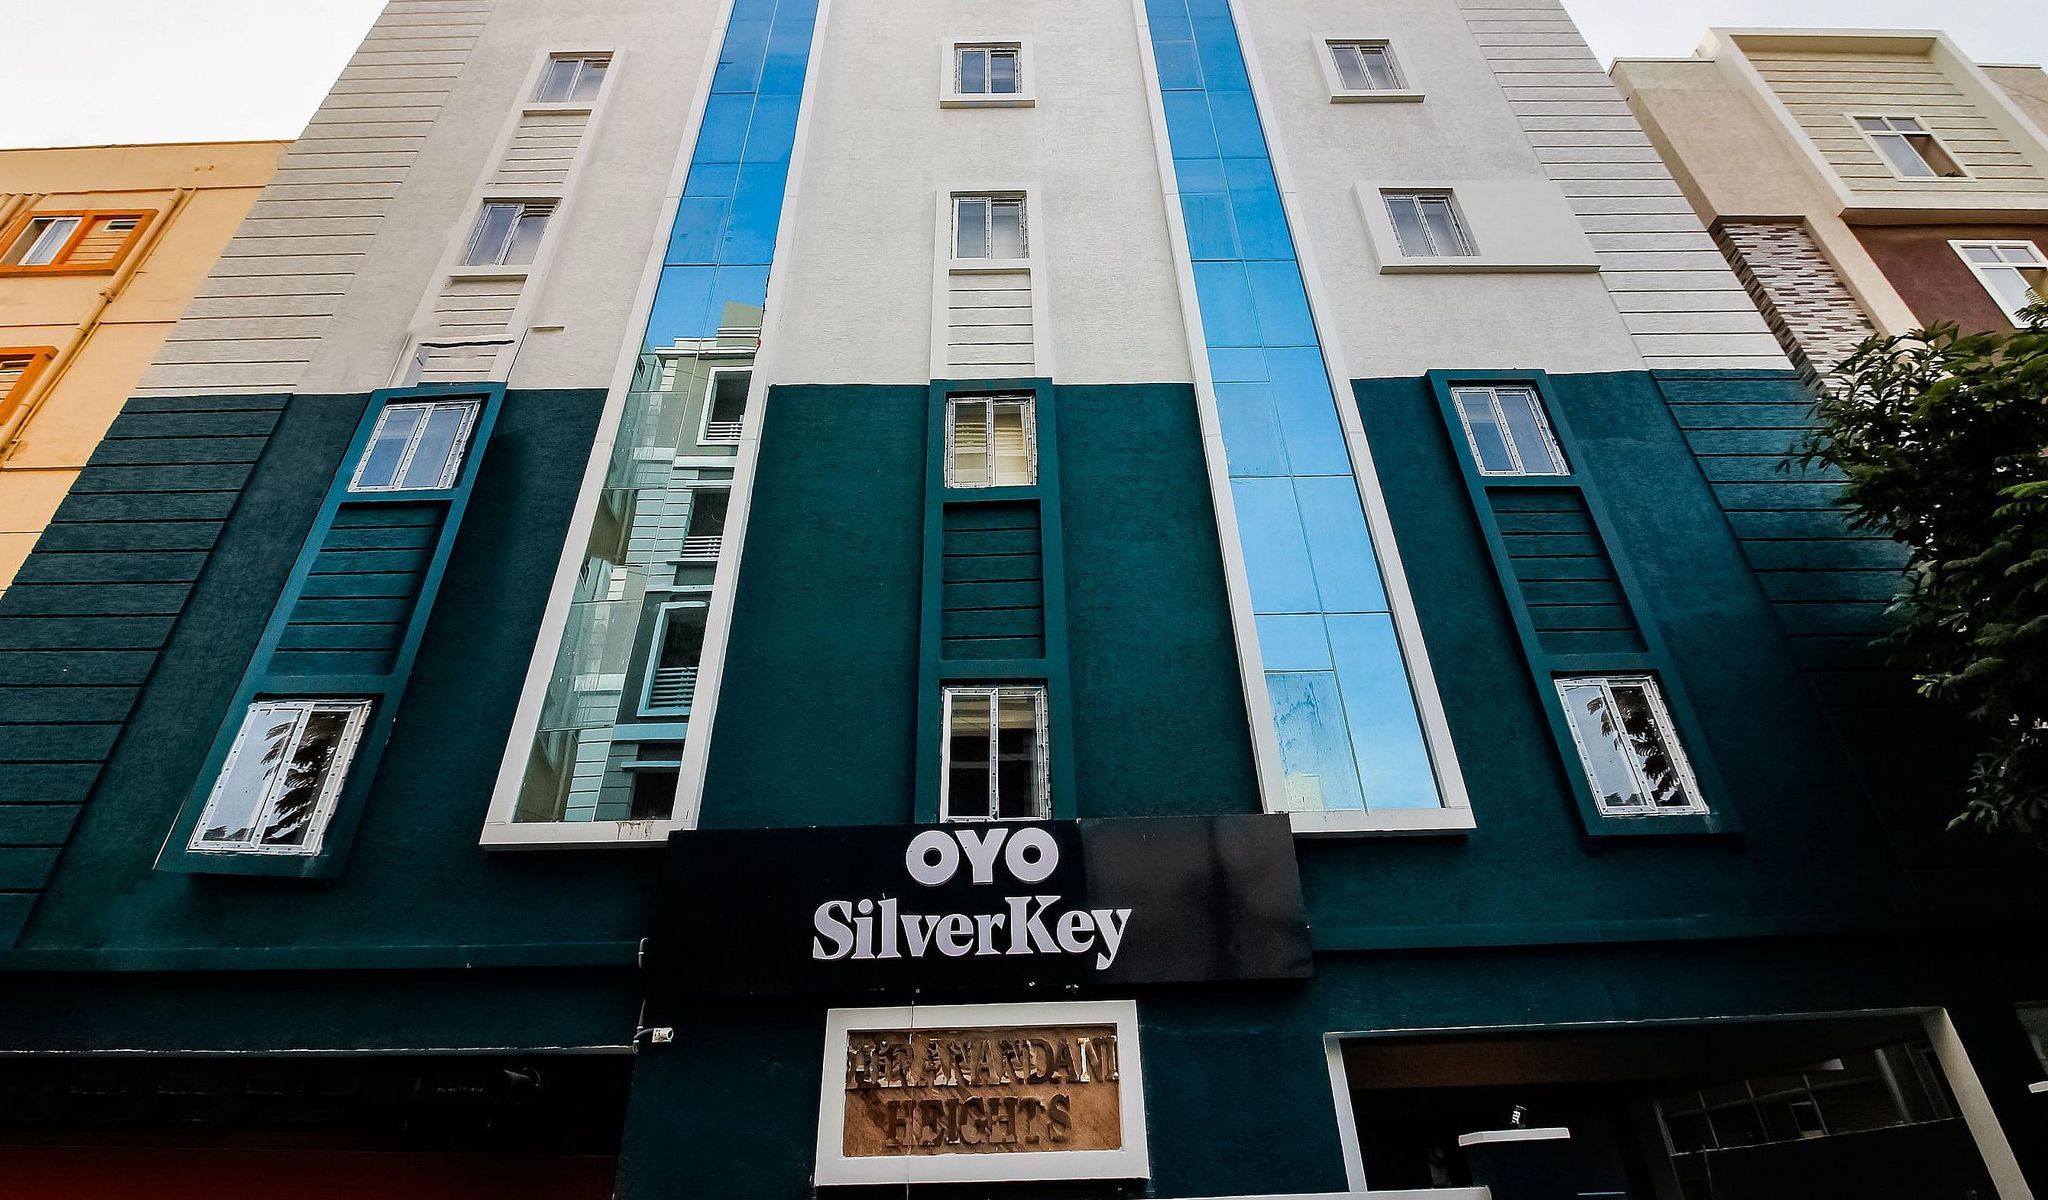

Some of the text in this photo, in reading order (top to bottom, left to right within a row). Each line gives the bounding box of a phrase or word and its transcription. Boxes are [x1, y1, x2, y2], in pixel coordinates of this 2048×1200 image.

[905, 826, 1059, 885] OYO
[812, 894, 1133, 970] SilverKey
[885, 1093, 1073, 1147] HEIGHTS
